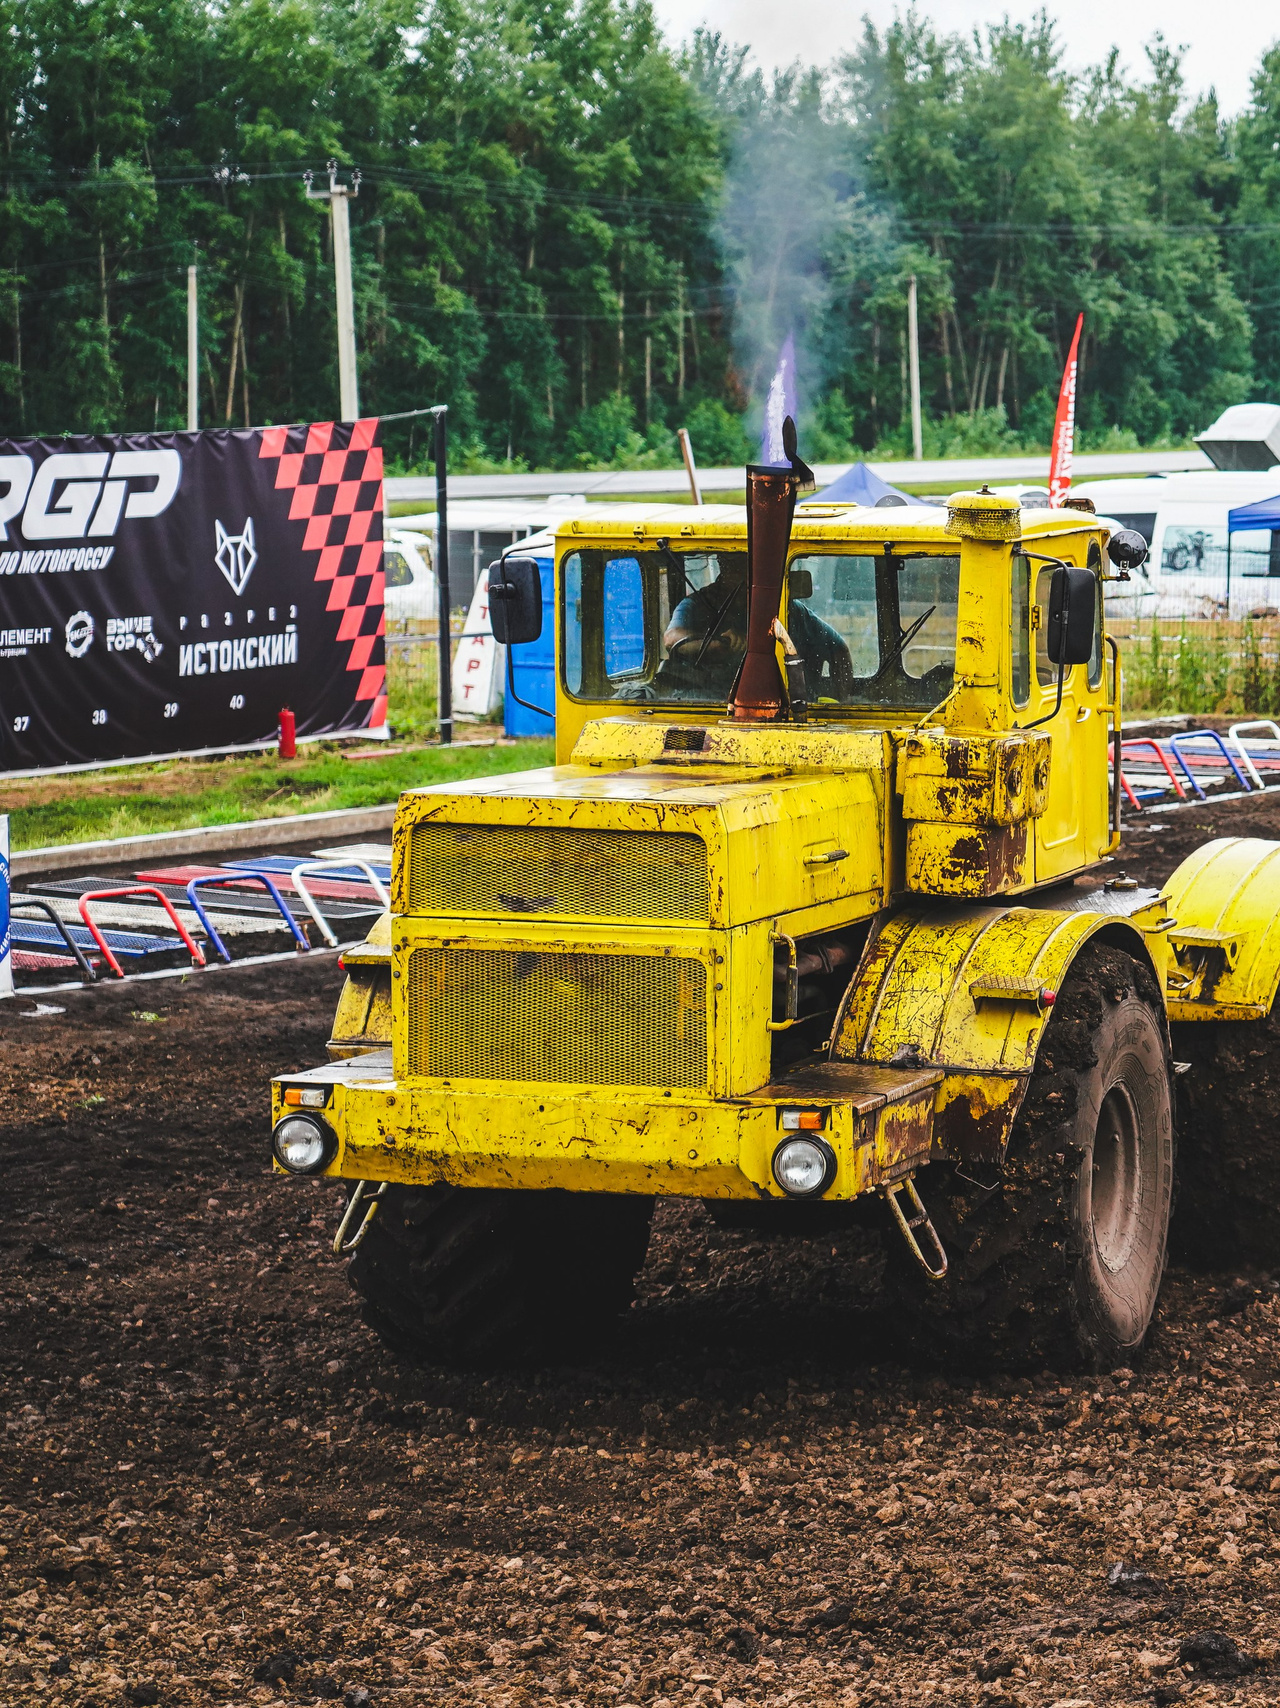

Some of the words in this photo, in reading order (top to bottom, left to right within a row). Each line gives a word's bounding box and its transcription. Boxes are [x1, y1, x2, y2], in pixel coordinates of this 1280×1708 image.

[17, 546, 115, 574] МОТОКРОССУ
[0, 628, 52, 646] ЛЕМЕНТ
[179, 624, 299, 677] ИСТОКСКИЙ
[163, 702, 179, 718] 39
[229, 694, 245, 710] 40
[13, 716, 30, 732] 37
[92, 709, 107, 725] 38
